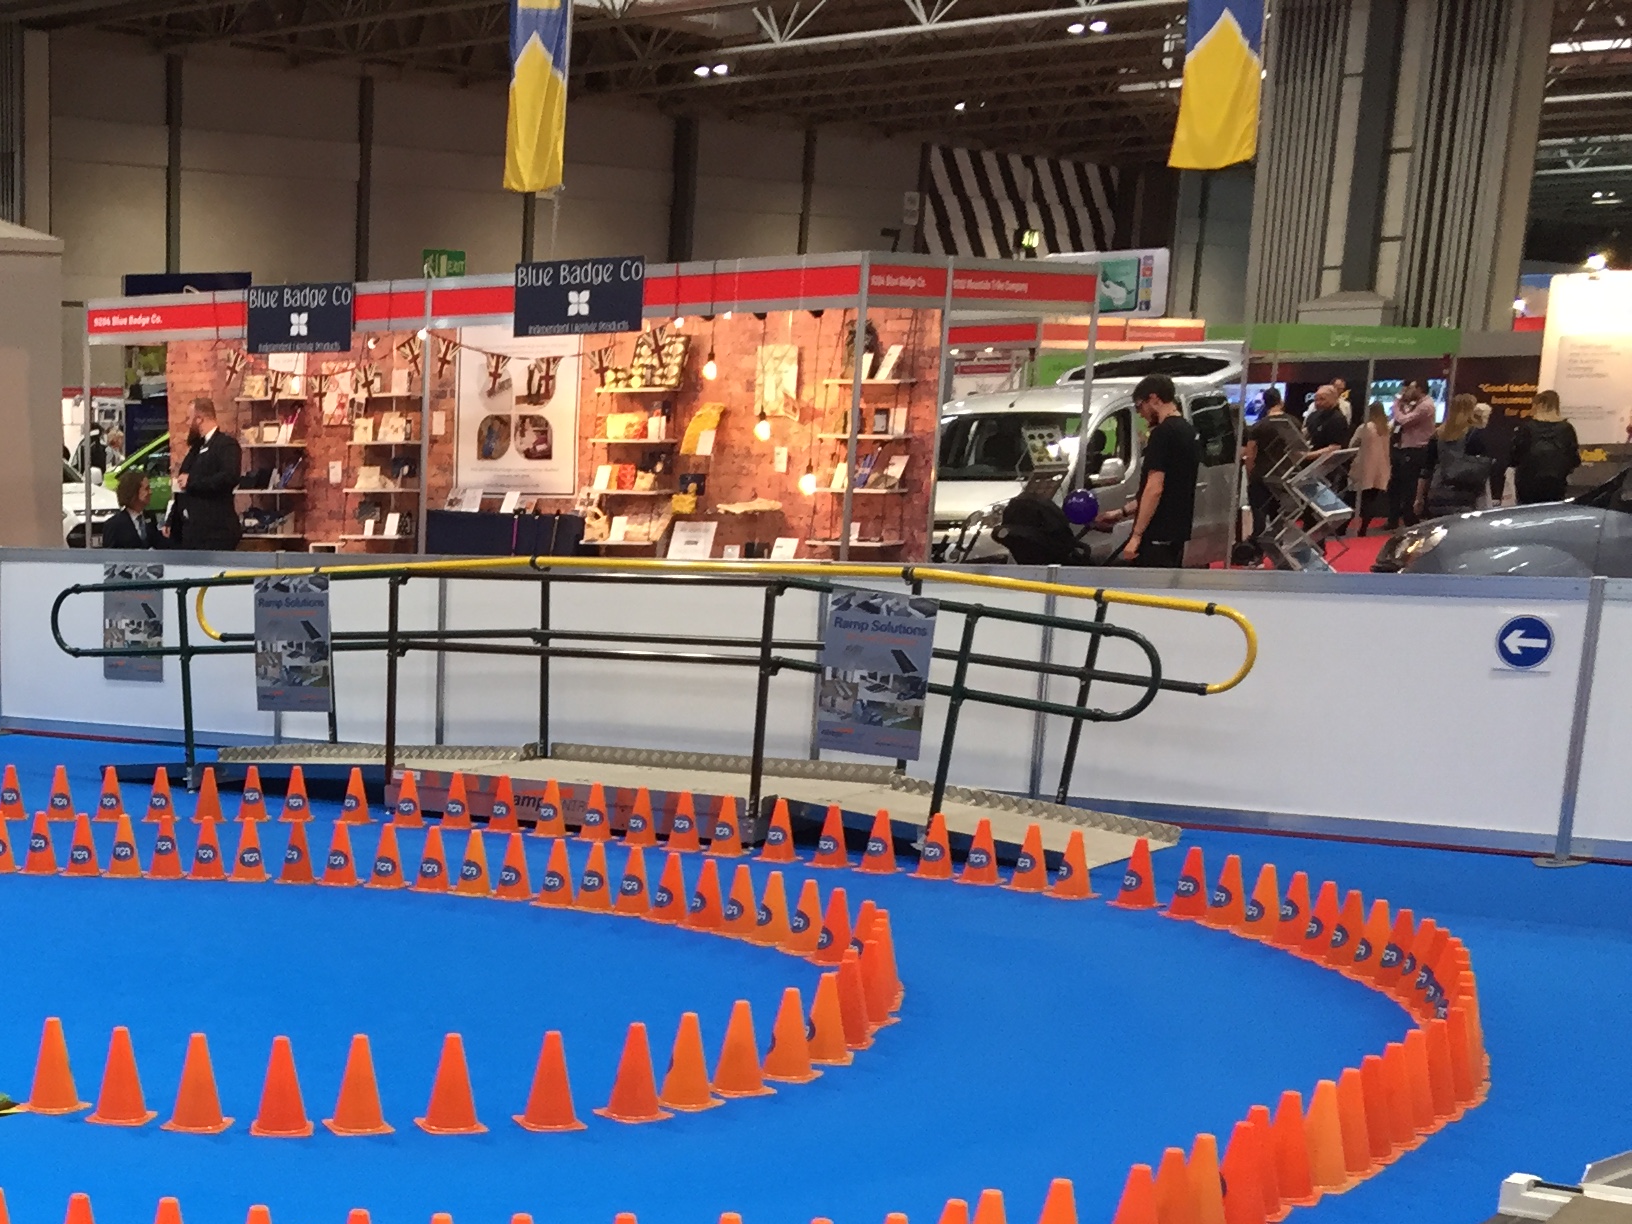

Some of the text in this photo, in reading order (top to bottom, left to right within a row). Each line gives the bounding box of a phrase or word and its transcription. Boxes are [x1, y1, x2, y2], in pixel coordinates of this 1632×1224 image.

[447, 260, 465, 273] EXIT
[517, 260, 643, 288] Blue Badge Co
[249, 286, 352, 308] Blue Badge Co
[112, 315, 128, 326] Blue
[129, 314, 150, 327] Badge
[151, 313, 163, 324] Co.
[257, 596, 326, 609] Ramp Solutions
[834, 616, 928, 637] Ramp Solutions
[54, 796, 67, 806] TGA
[399, 803, 413, 811] TGA
[448, 804, 461, 812] TGA
[494, 806, 506, 814] TGA
[541, 808, 553, 816] TGA
[586, 814, 599, 822] TGA
[675, 820, 689, 828] TGA
[716, 827, 729, 835] TGA
[769, 832, 782, 840] TGA
[32, 839, 45, 847] TGA
[158, 842, 171, 850] TGA
[820, 841, 833, 849] TGA
[868, 842, 883, 851] TGA
[72, 851, 88, 859] TGA
[115, 846, 130, 856] TGA
[198, 850, 213, 858] TGA
[925, 849, 940, 857] TGA
[242, 853, 259, 862] TGA
[330, 856, 344, 864] TGA
[970, 855, 986, 863] TGA
[377, 862, 392, 871] TGA
[423, 864, 437, 872] TGA
[545, 877, 559, 886] TGA
[584, 876, 598, 886] TGA
[623, 881, 638, 890] TGA
[1178, 881, 1194, 891] TGA
